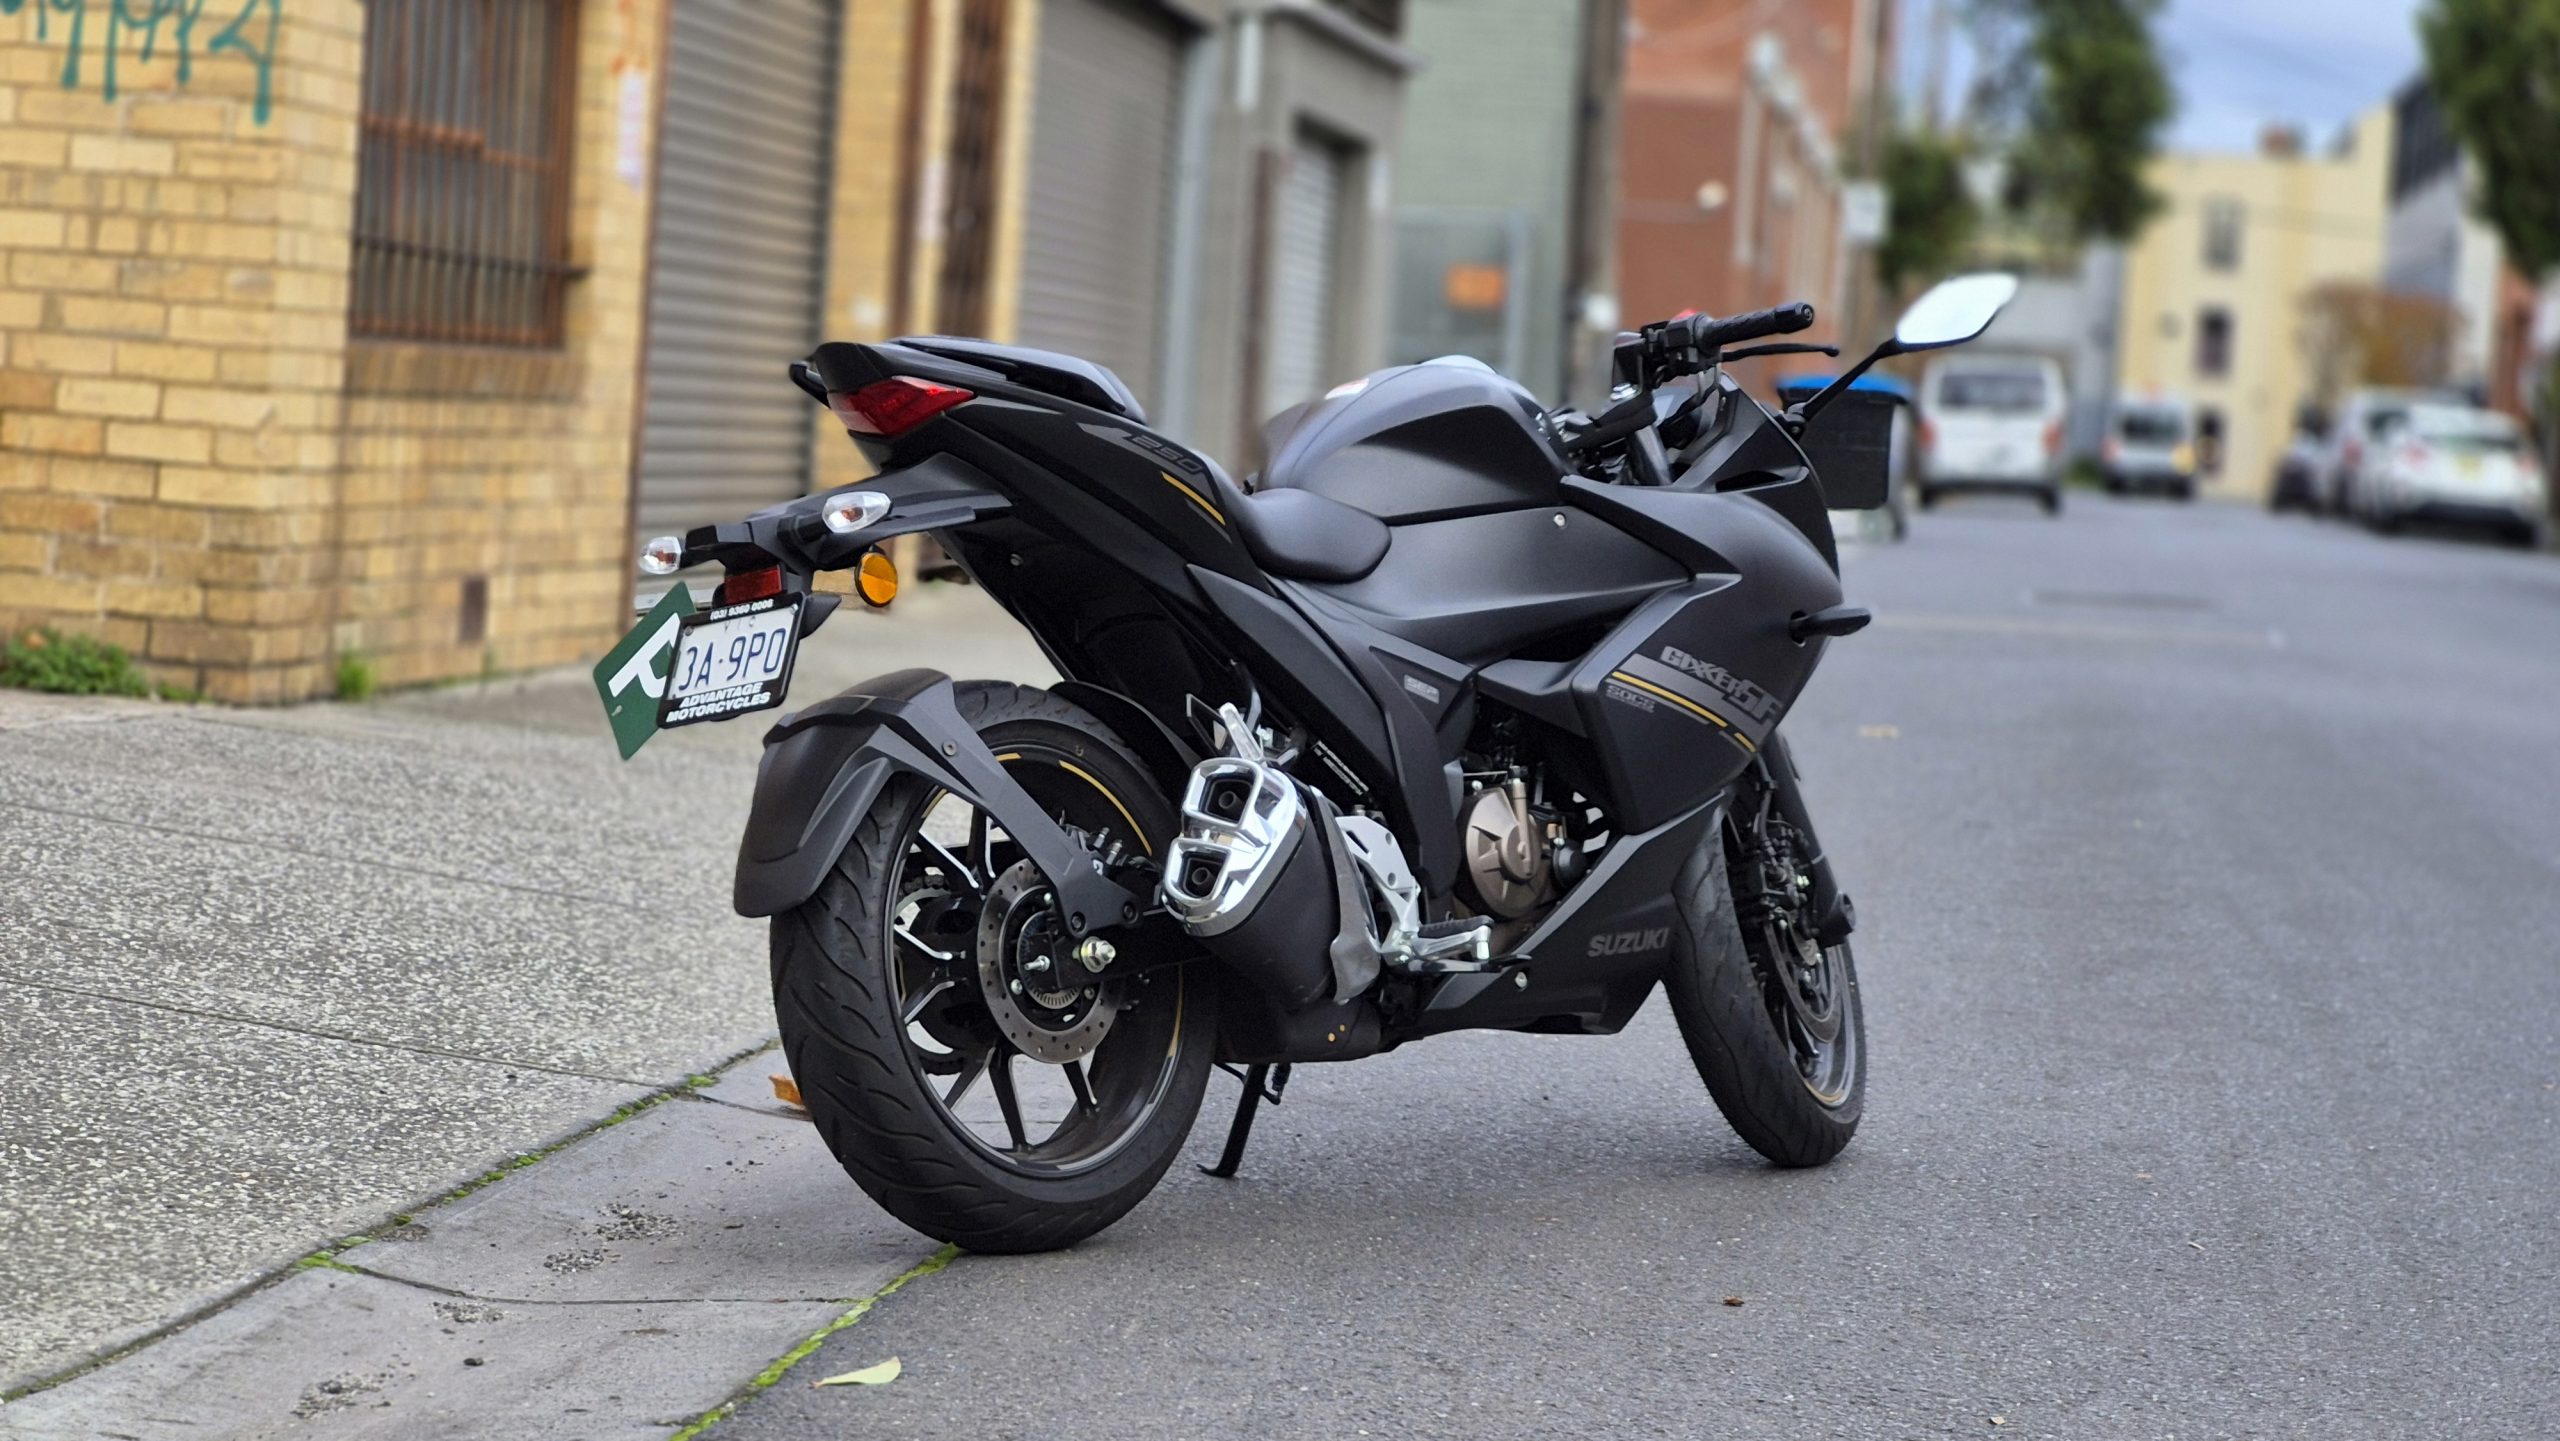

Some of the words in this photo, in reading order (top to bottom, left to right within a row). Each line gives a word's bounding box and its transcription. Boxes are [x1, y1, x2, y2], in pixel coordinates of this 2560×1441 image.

[1132, 435, 1203, 473] 250
[710, 609, 728, 621] (03)
[666, 692, 772, 723] MOTORCYCLES
[679, 682, 764, 709] ADVANTAGE
[1587, 927, 1670, 957] SUZUKI
